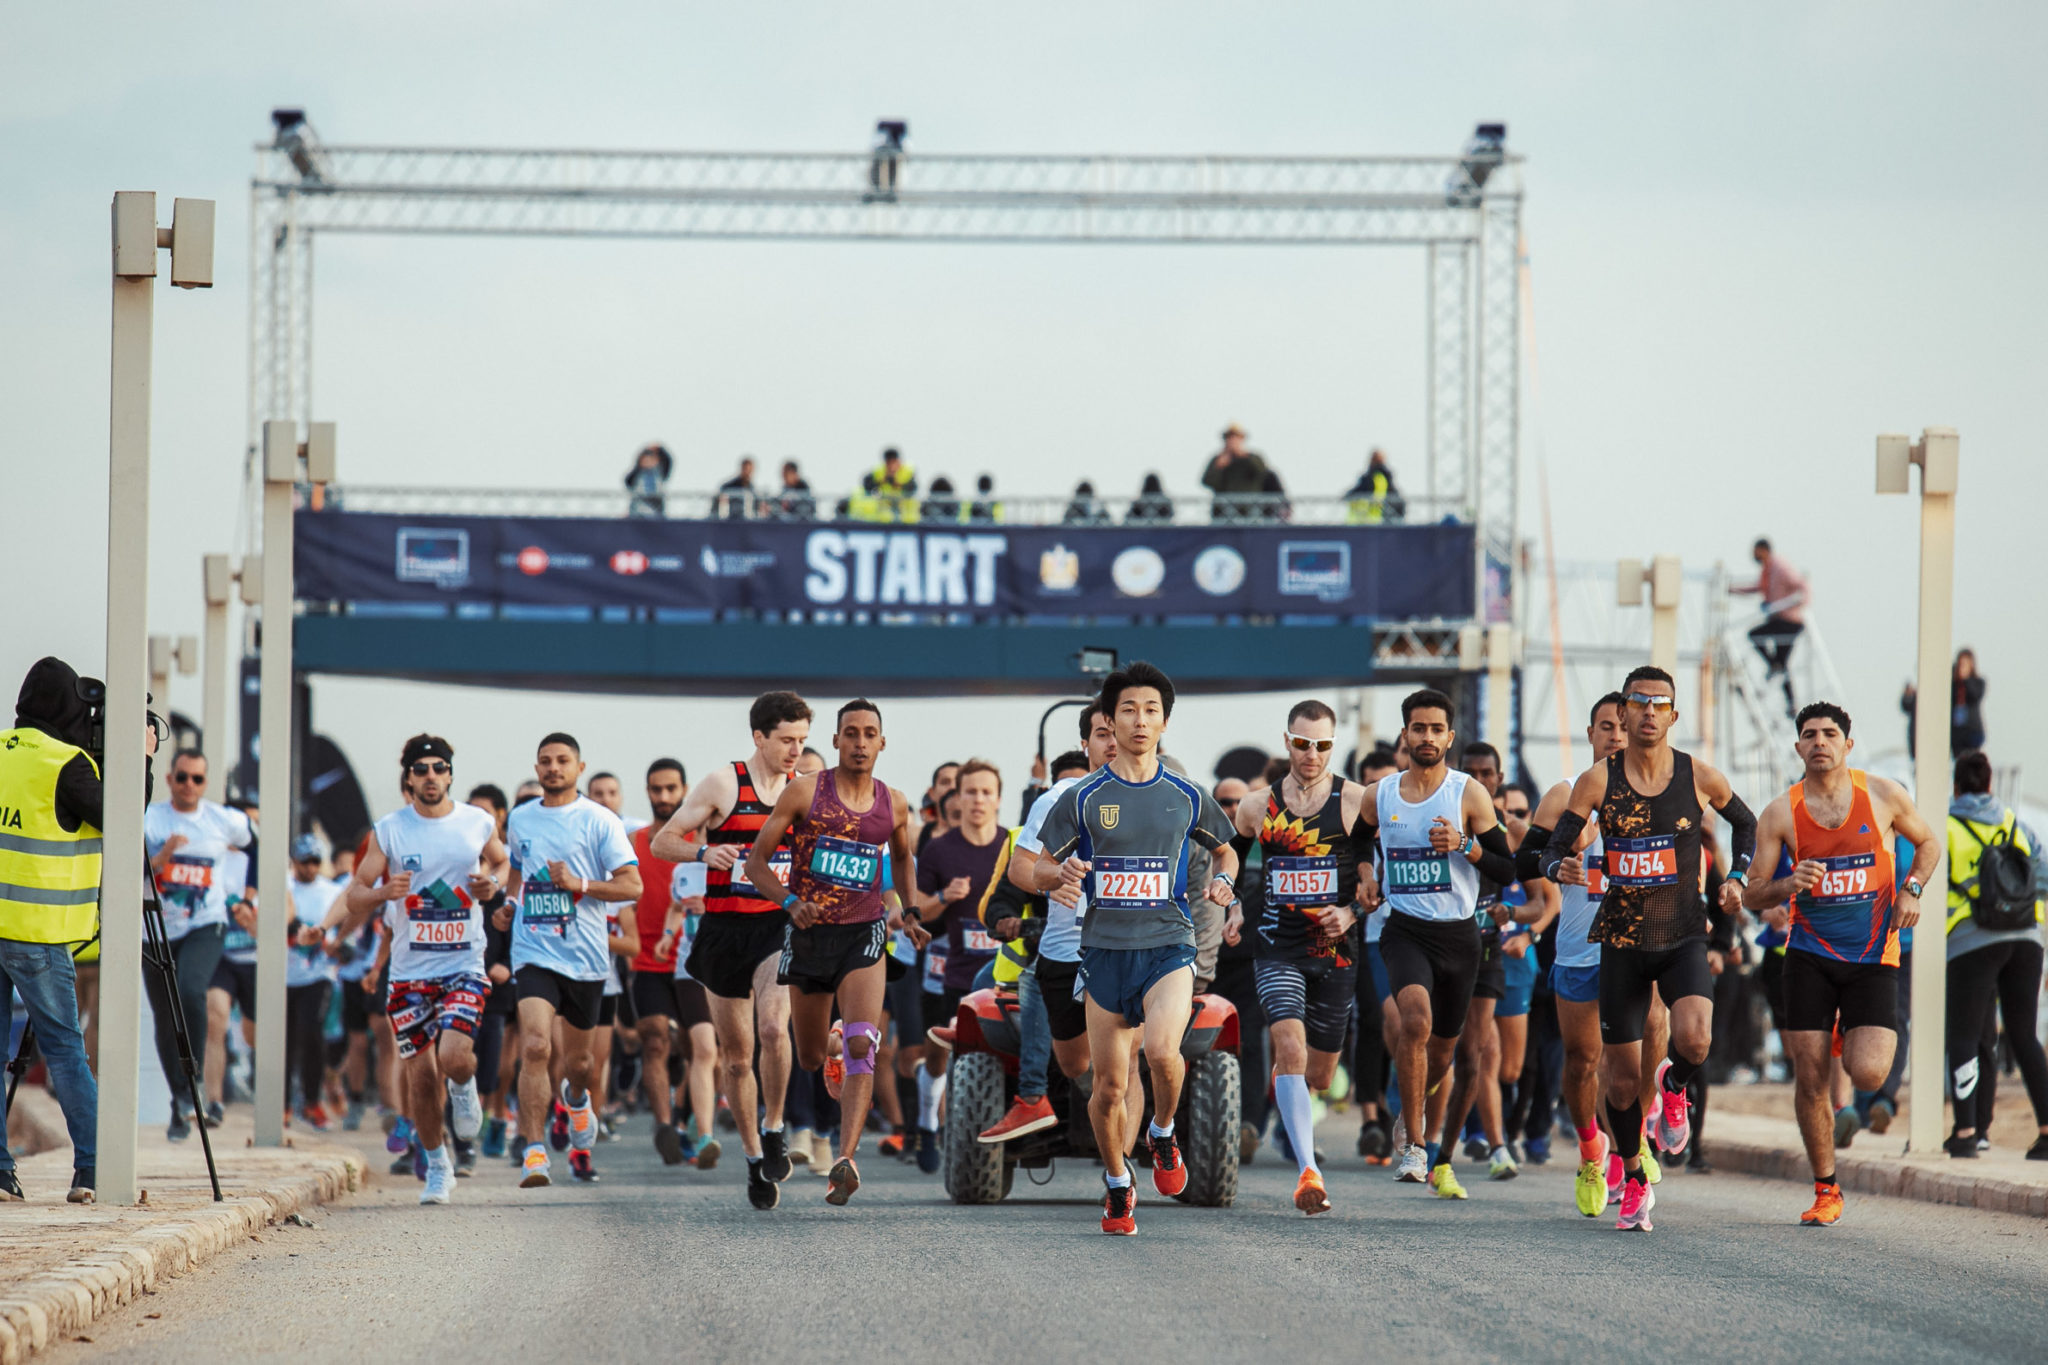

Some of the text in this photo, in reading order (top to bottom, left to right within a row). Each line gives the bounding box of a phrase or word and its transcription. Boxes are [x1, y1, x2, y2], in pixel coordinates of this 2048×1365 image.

[806, 530, 1007, 606] START
[0, 806, 22, 829] IA
[820, 850, 871, 881] 11433
[1394, 861, 1441, 884] 11389
[1618, 852, 1665, 876] 6754
[1102, 873, 1161, 898] 22241
[1279, 871, 1331, 894] 21557
[1821, 869, 1867, 895] 6579
[528, 894, 570, 915] 10580
[416, 921, 464, 942] 21609
